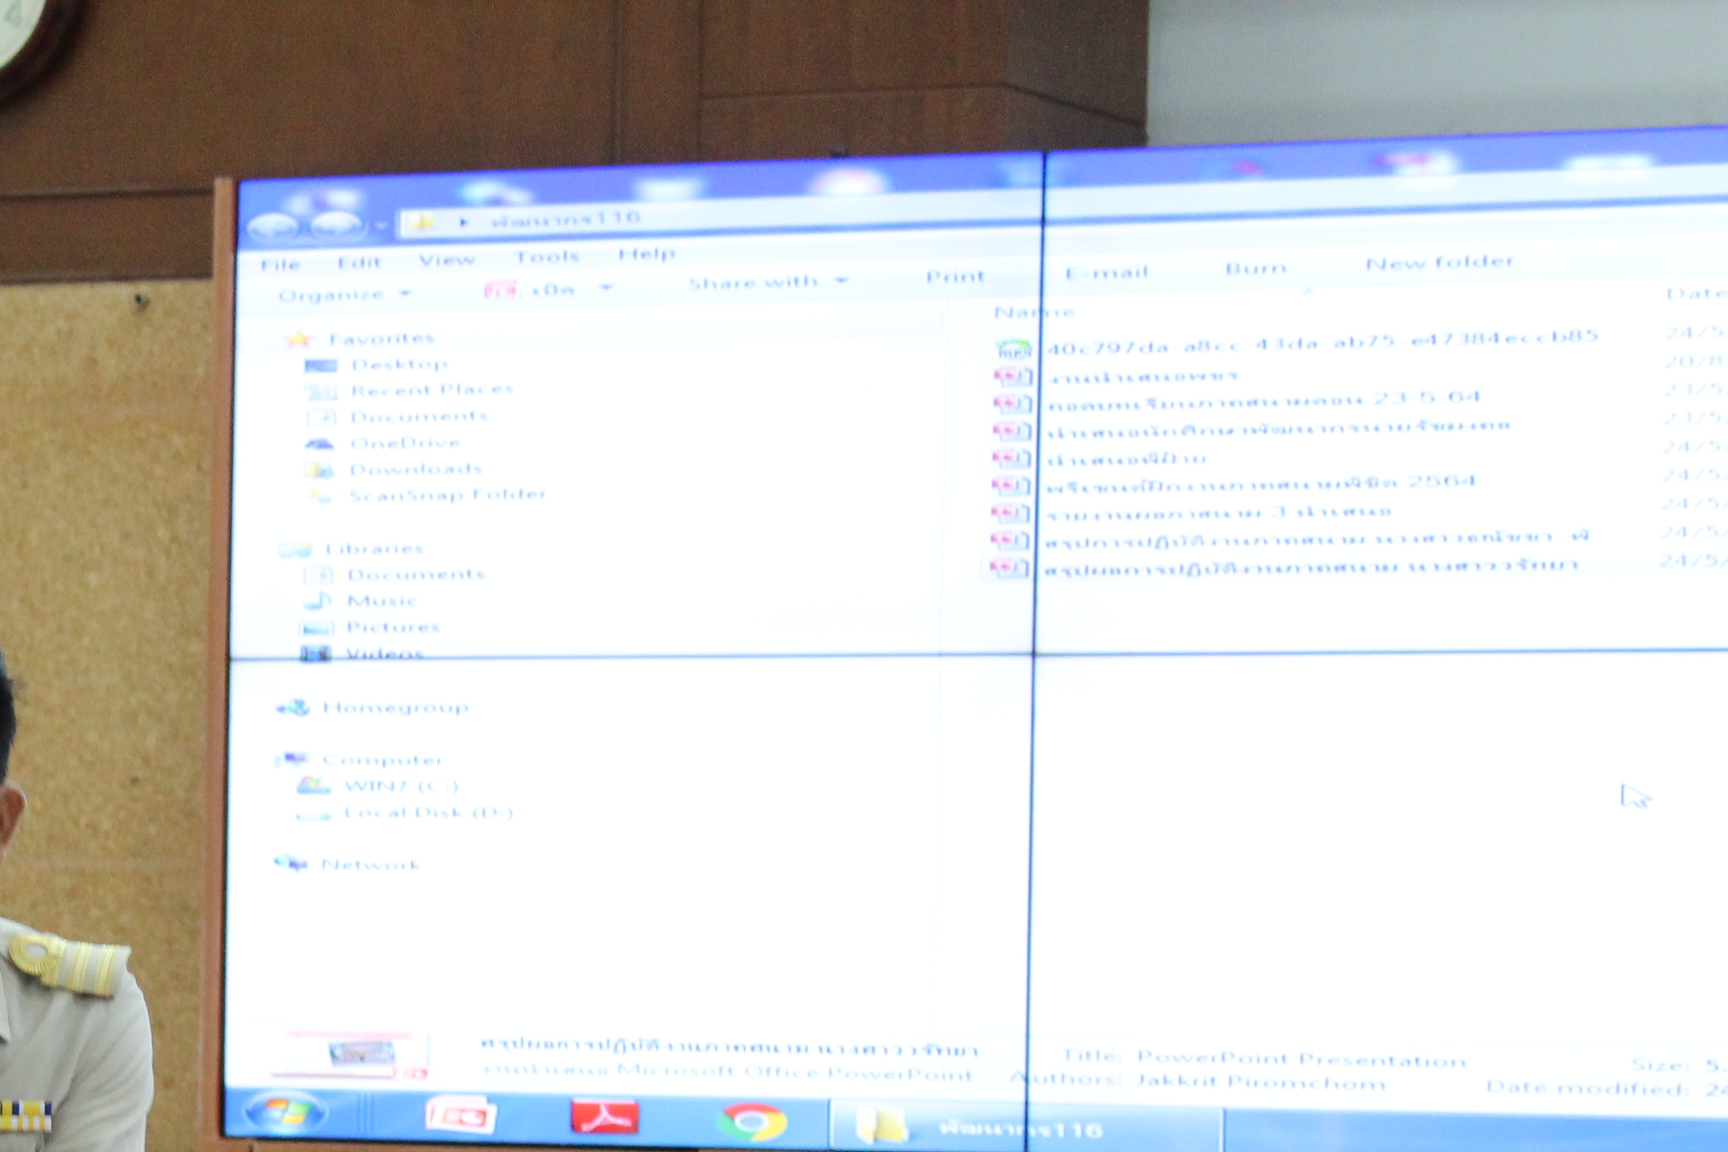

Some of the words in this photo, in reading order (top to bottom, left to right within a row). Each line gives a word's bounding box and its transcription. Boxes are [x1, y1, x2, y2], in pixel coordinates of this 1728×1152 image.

[261, 258, 301, 272] File
[338, 256, 381, 270] Edit
[418, 254, 477, 267] View
[514, 249, 581, 264] Tools
[619, 247, 676, 263] Help
[1066, 265, 1149, 281] E-mail
[1226, 262, 1287, 276] Burn
[1366, 257, 1427, 272] New
[1435, 254, 1514, 269] folder
[278, 289, 384, 306] Organize
[689, 277, 757, 291] Share
[764, 274, 819, 288] with
[926, 270, 987, 284] Print
[330, 332, 435, 347] Favorites
[352, 358, 448, 373] Desktop
[351, 385, 431, 397] Recent
[440, 383, 514, 395] Places
[351, 410, 488, 424] Documents
[350, 436, 461, 450] OneDrive
[350, 462, 483, 476] Downloads
[1408, 474, 1476, 488] 2564
[350, 489, 464, 504] ScanSnap
[473, 488, 545, 500] Folder
[1273, 505, 1287, 518] 3
[326, 542, 424, 555] Libraries
[348, 568, 485, 581] Documents
[347, 594, 415, 607] Music
[347, 620, 440, 634] Pictures
[346, 648, 424, 658] Videos
[323, 701, 469, 717] Homegroup
[322, 755, 442, 769] Computer
[344, 780, 408, 792] WIN7
[345, 806, 406, 818] Local
[415, 806, 462, 818] Disk
[321, 858, 420, 871] Network
[1064, 1048, 1121, 1062] Title:
[1138, 1050, 1289, 1065] PowerPoint
[1299, 1052, 1467, 1068] Presentation
[1632, 1057, 1690, 1072] Size:
[617, 1062, 734, 1077] Microsoft
[744, 1066, 819, 1079] Office
[828, 1066, 973, 1083] PowerPoint
[1138, 1073, 1217, 1087] Jakkrit
[1228, 1075, 1386, 1091] Piromchom
[1487, 1079, 1550, 1095] Date
[1558, 1082, 1689, 1096] modified:
